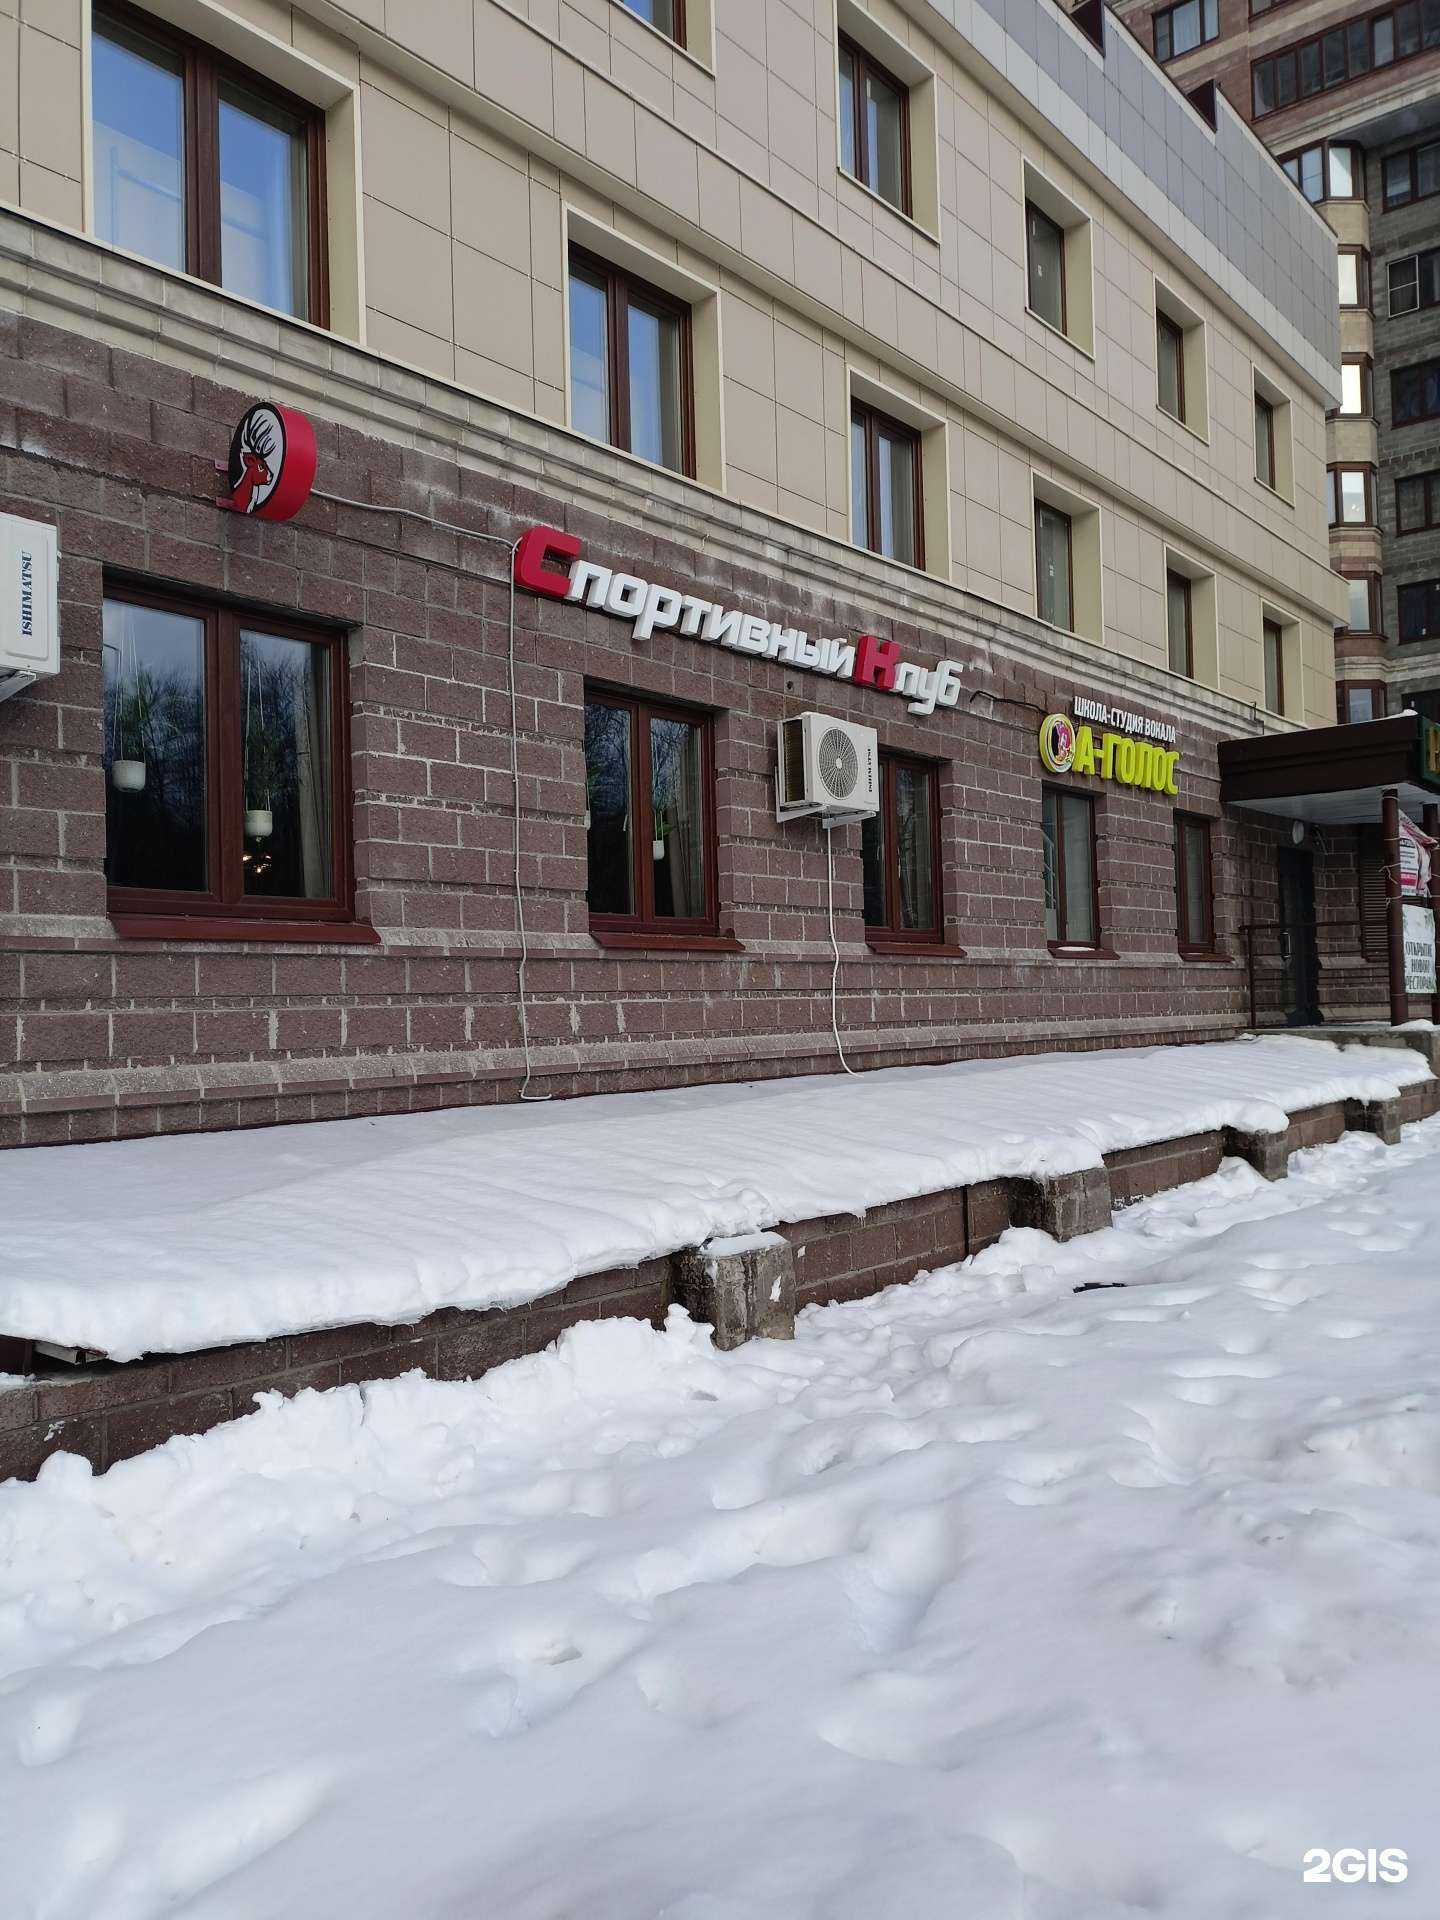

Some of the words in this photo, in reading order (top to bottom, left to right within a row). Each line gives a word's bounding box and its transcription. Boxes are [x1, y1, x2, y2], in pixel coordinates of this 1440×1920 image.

[21, 550, 33, 637] ISHIMATSU
[514, 526, 855, 679] Спортивный
[855, 635, 964, 715] Клуб
[1073, 695, 1145, 734] ШКОЛА-СТУДИЯ
[1144, 718, 1177, 744] ВОКАЛА
[1072, 725, 1180, 795] А-ГОЛОС
